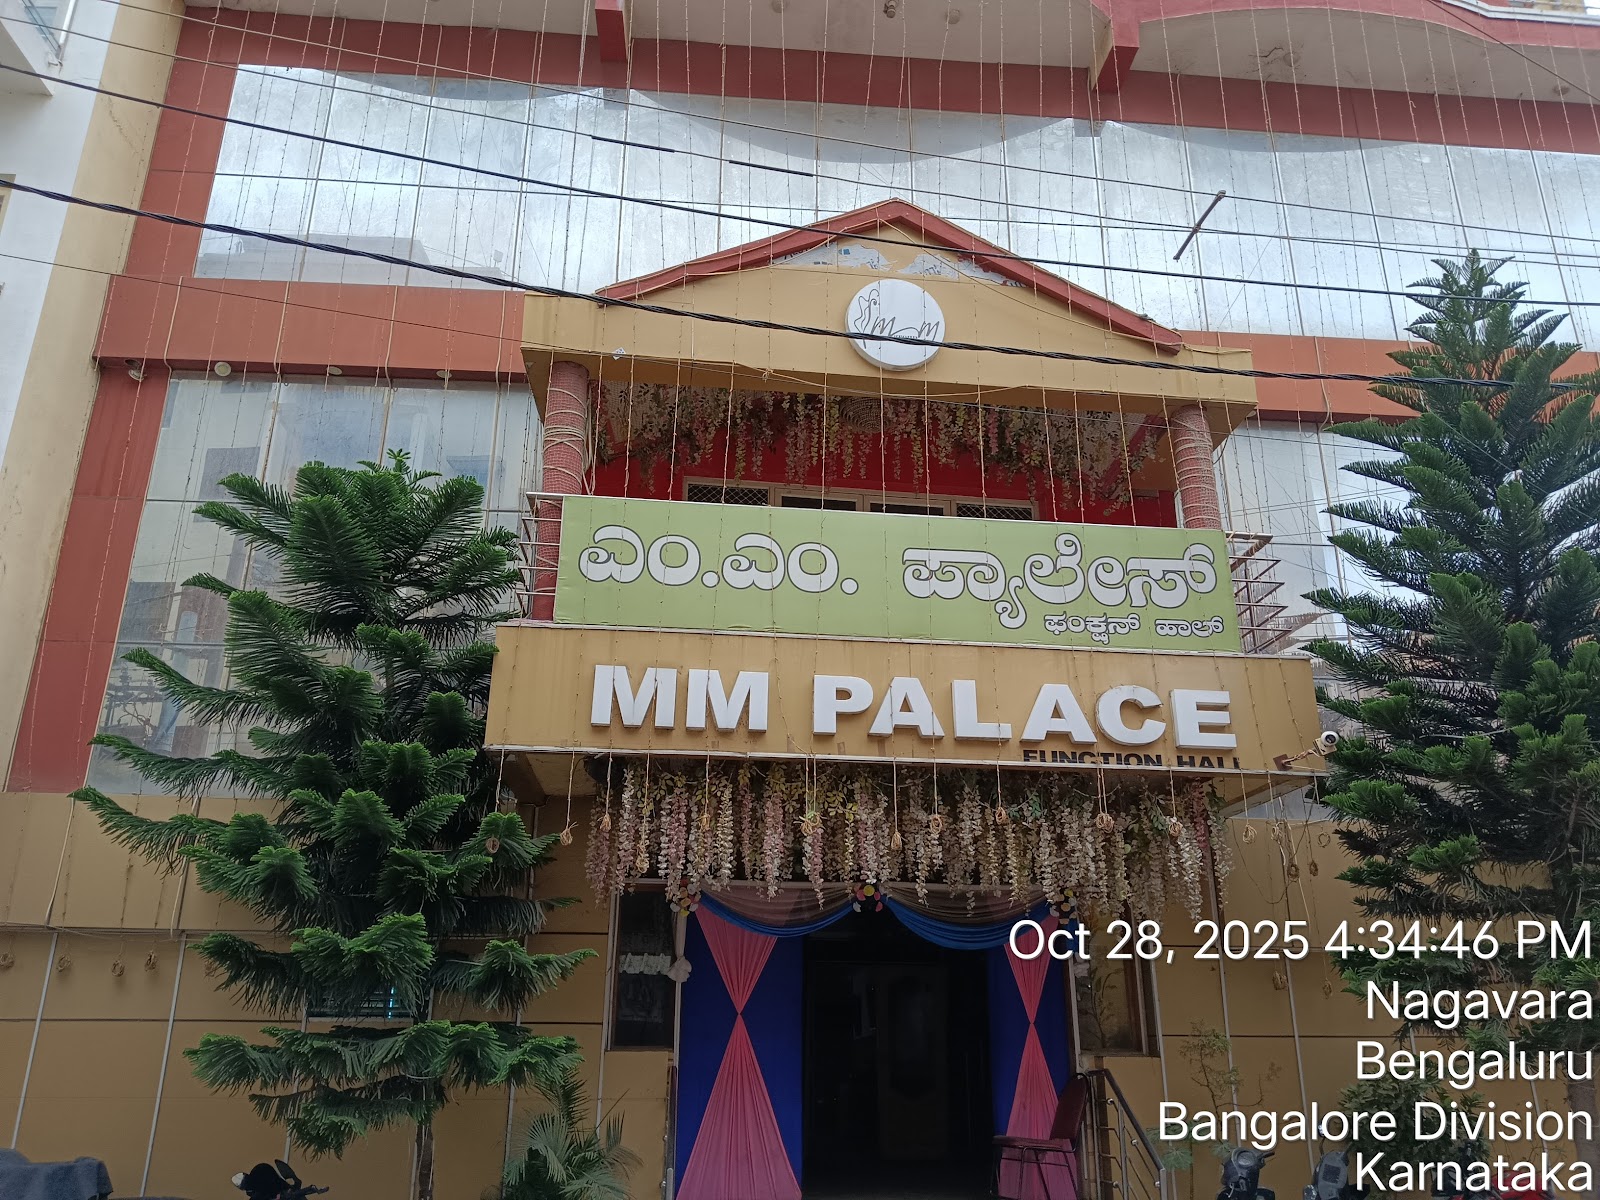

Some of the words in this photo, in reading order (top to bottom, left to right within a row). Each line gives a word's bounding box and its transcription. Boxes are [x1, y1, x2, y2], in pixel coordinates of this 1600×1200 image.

[578, 524, 859, 596] ಎಂ.ಎಂ.
[902, 532, 1217, 629] ಪ್ಯಾಲೇಸ್
[1043, 611, 1141, 645] ಫಂಕ್ಷನ್
[1155, 615, 1224, 637] ಹಾಲ್
[591, 665, 769, 733] MM
[813, 675, 1237, 749] PALACE
